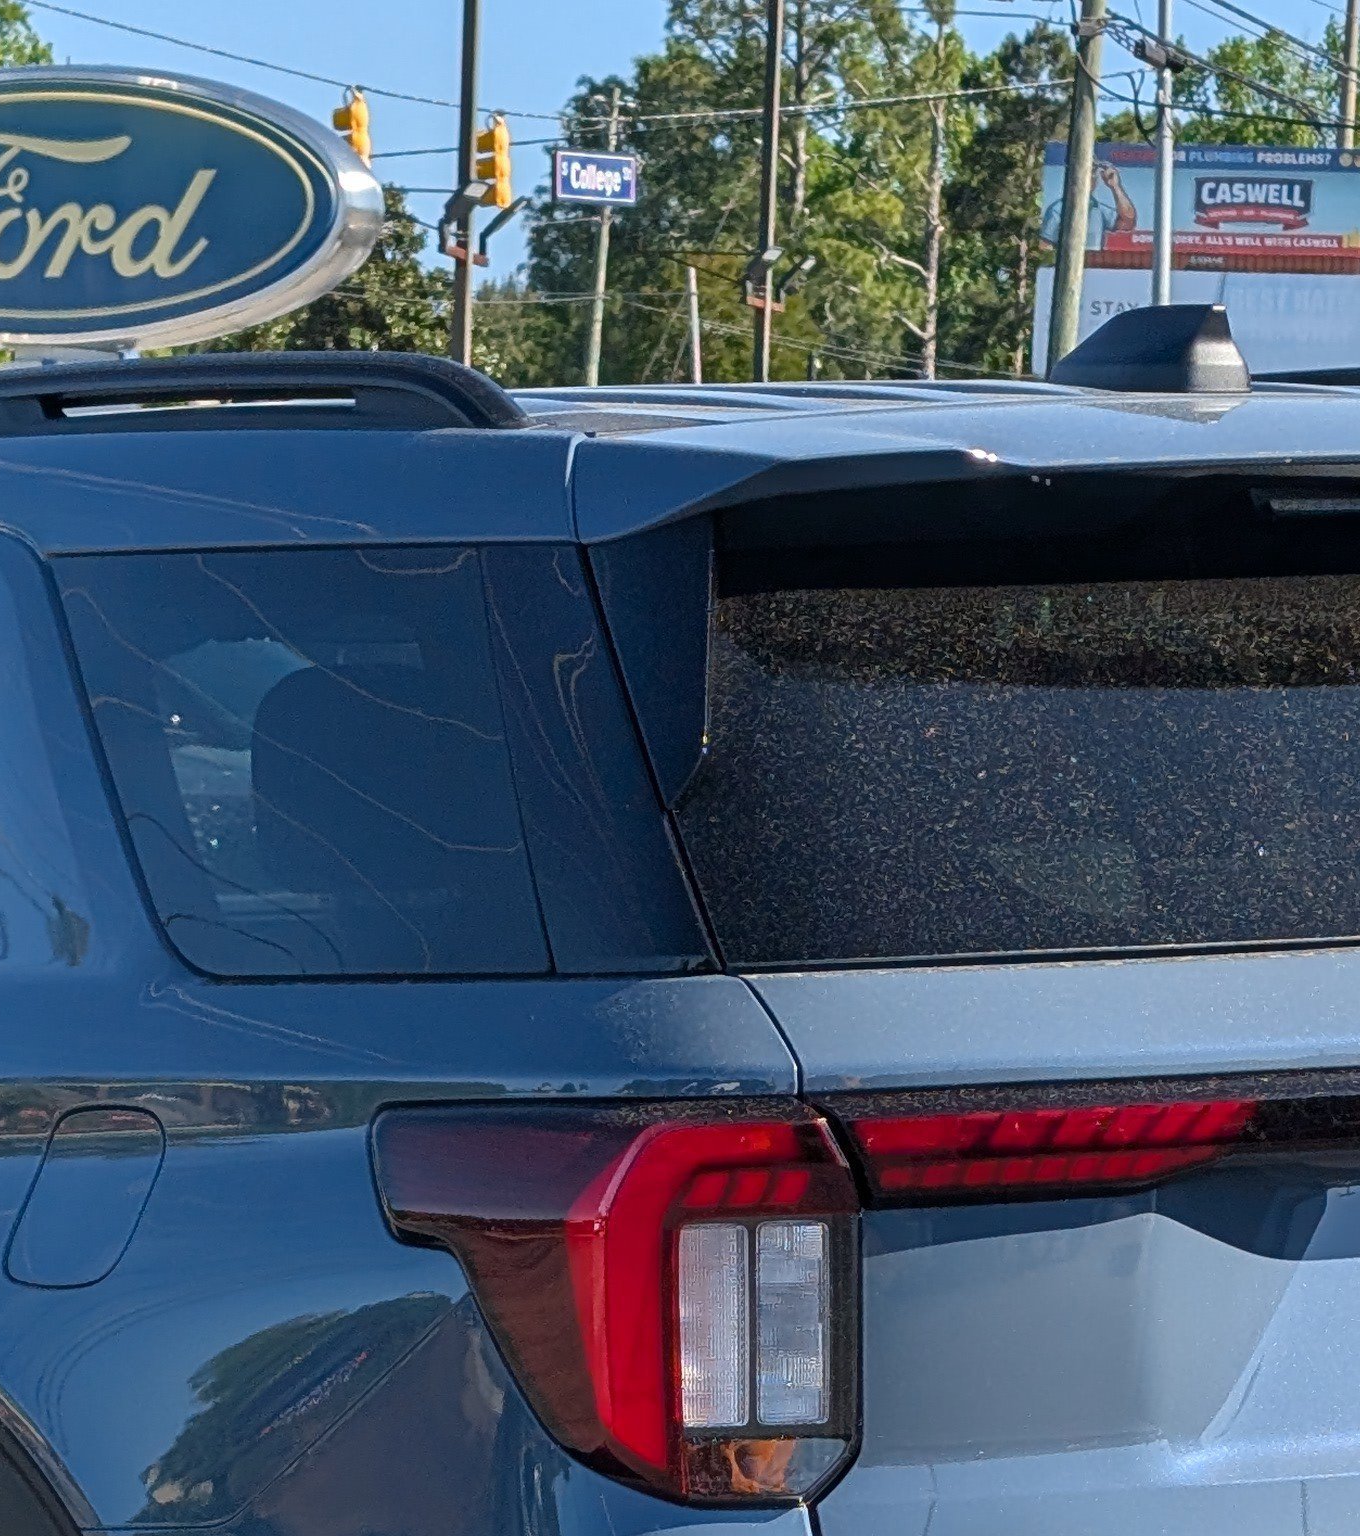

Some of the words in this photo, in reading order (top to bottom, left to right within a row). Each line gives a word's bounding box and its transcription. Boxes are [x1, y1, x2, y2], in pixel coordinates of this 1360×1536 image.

[1257, 152, 1332, 165] PROBLEMS?
[570, 162, 622, 197] College
[1200, 181, 1306, 208] CASWELL
[1235, 237, 1262, 247] WELL
[1264, 237, 1291, 247] WITH
[1293, 238, 1339, 249] CASWELL
